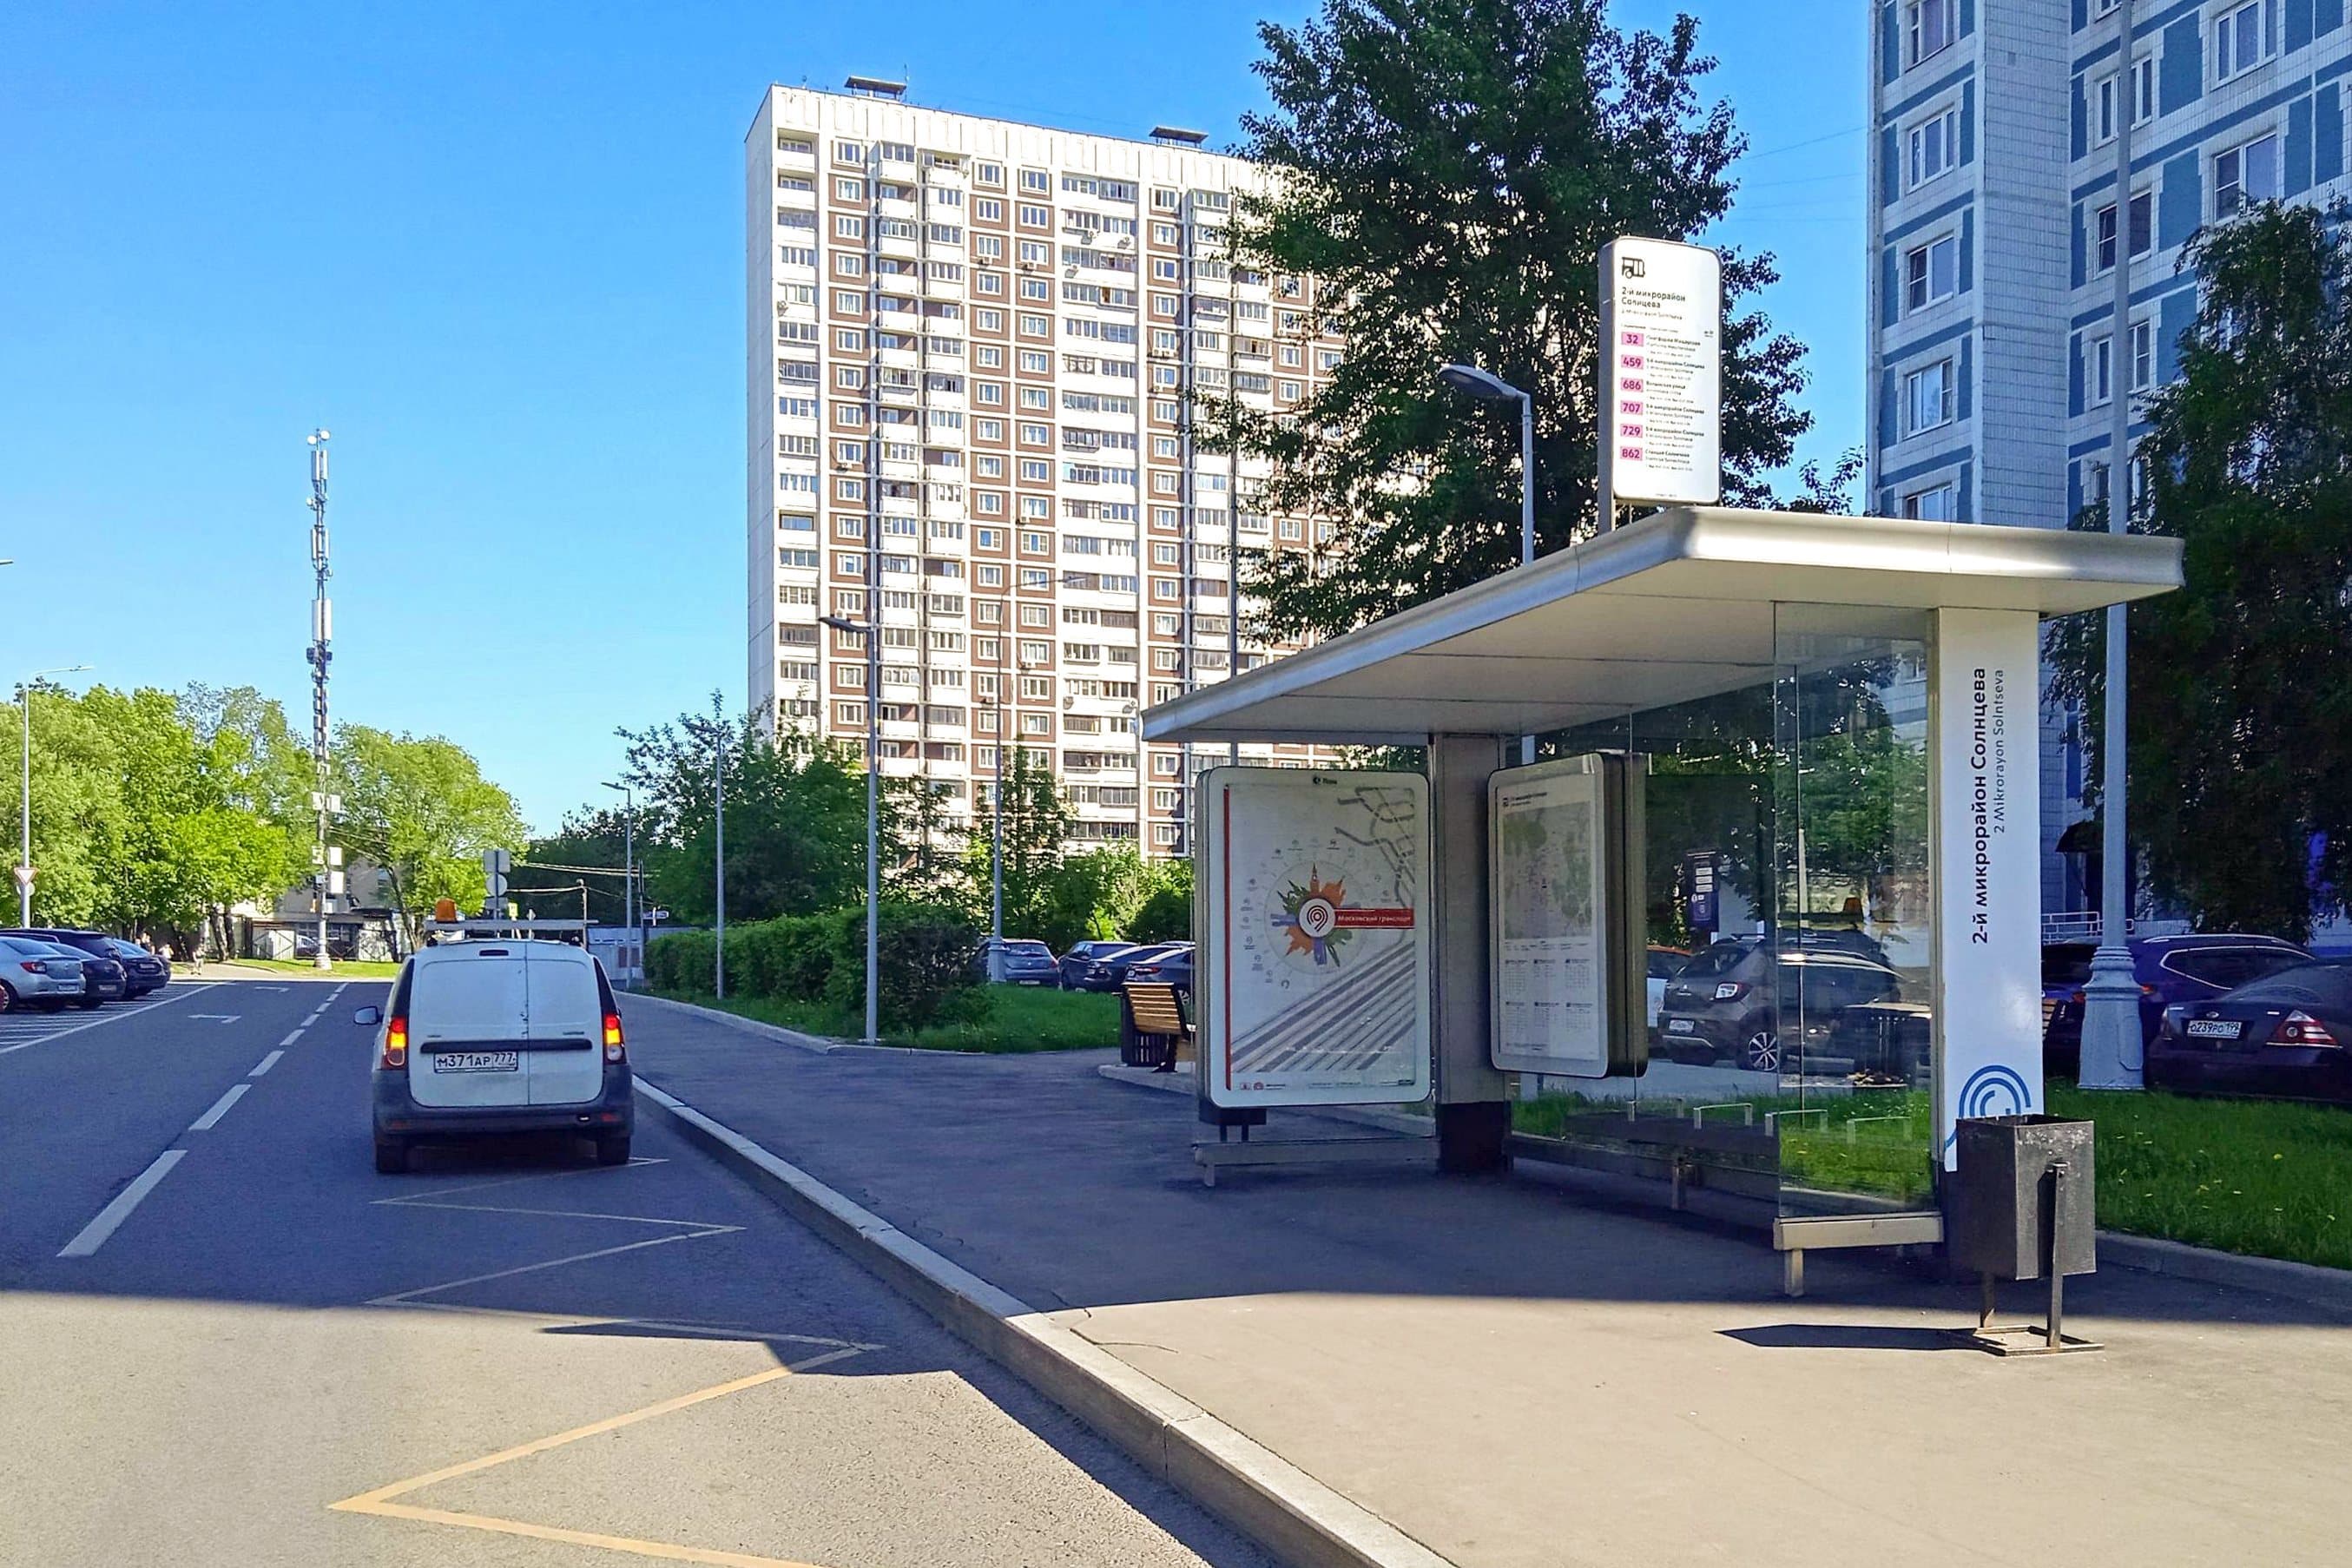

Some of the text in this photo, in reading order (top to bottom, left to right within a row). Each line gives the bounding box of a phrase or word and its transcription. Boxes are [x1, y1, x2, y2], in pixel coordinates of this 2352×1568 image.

[1636, 290, 1685, 301] микрорайон
[1621, 296, 1661, 308] Солнцева
[1626, 333, 1638, 345] 32
[1623, 357, 1641, 368] 459
[1623, 379, 1641, 391] 686
[1623, 402, 1641, 412] 707
[1622, 425, 1641, 436] 729
[1622, 448, 1640, 459] 862
[1993, 669, 2006, 833] 2 Mikrorayon Solntseva
[1970, 668, 1990, 944] 2-й микрорайон Солнцева
[493, 1052, 513, 1063] 777
